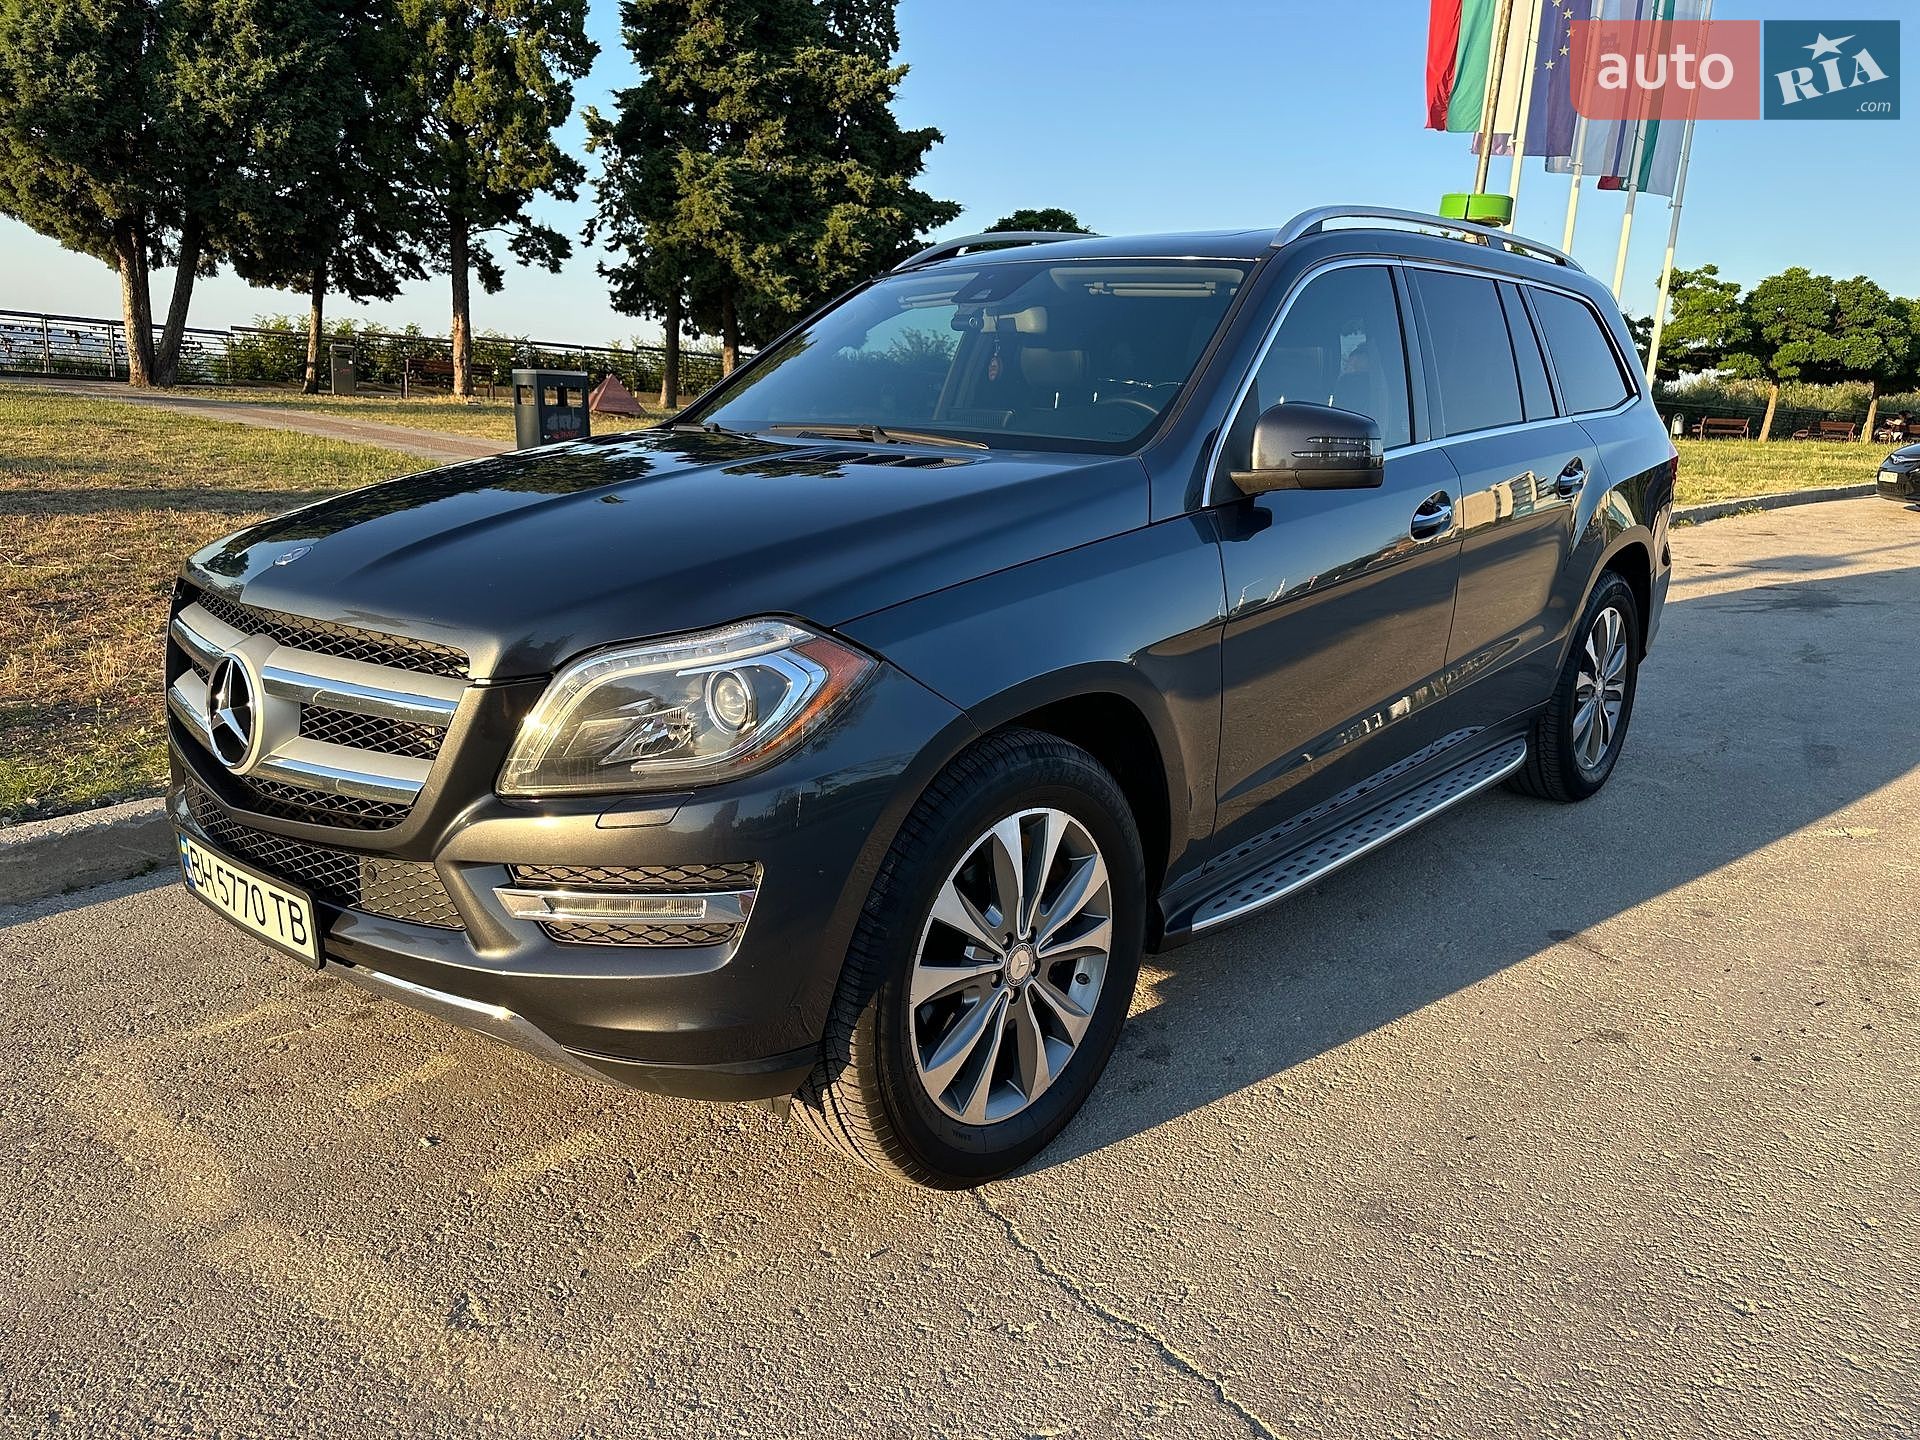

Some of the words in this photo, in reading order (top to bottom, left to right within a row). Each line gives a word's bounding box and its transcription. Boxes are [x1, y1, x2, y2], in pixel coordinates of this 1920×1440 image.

[189, 845, 217, 899] BH
[216, 863, 267, 927] 5770
[268, 890, 307, 946] TB
